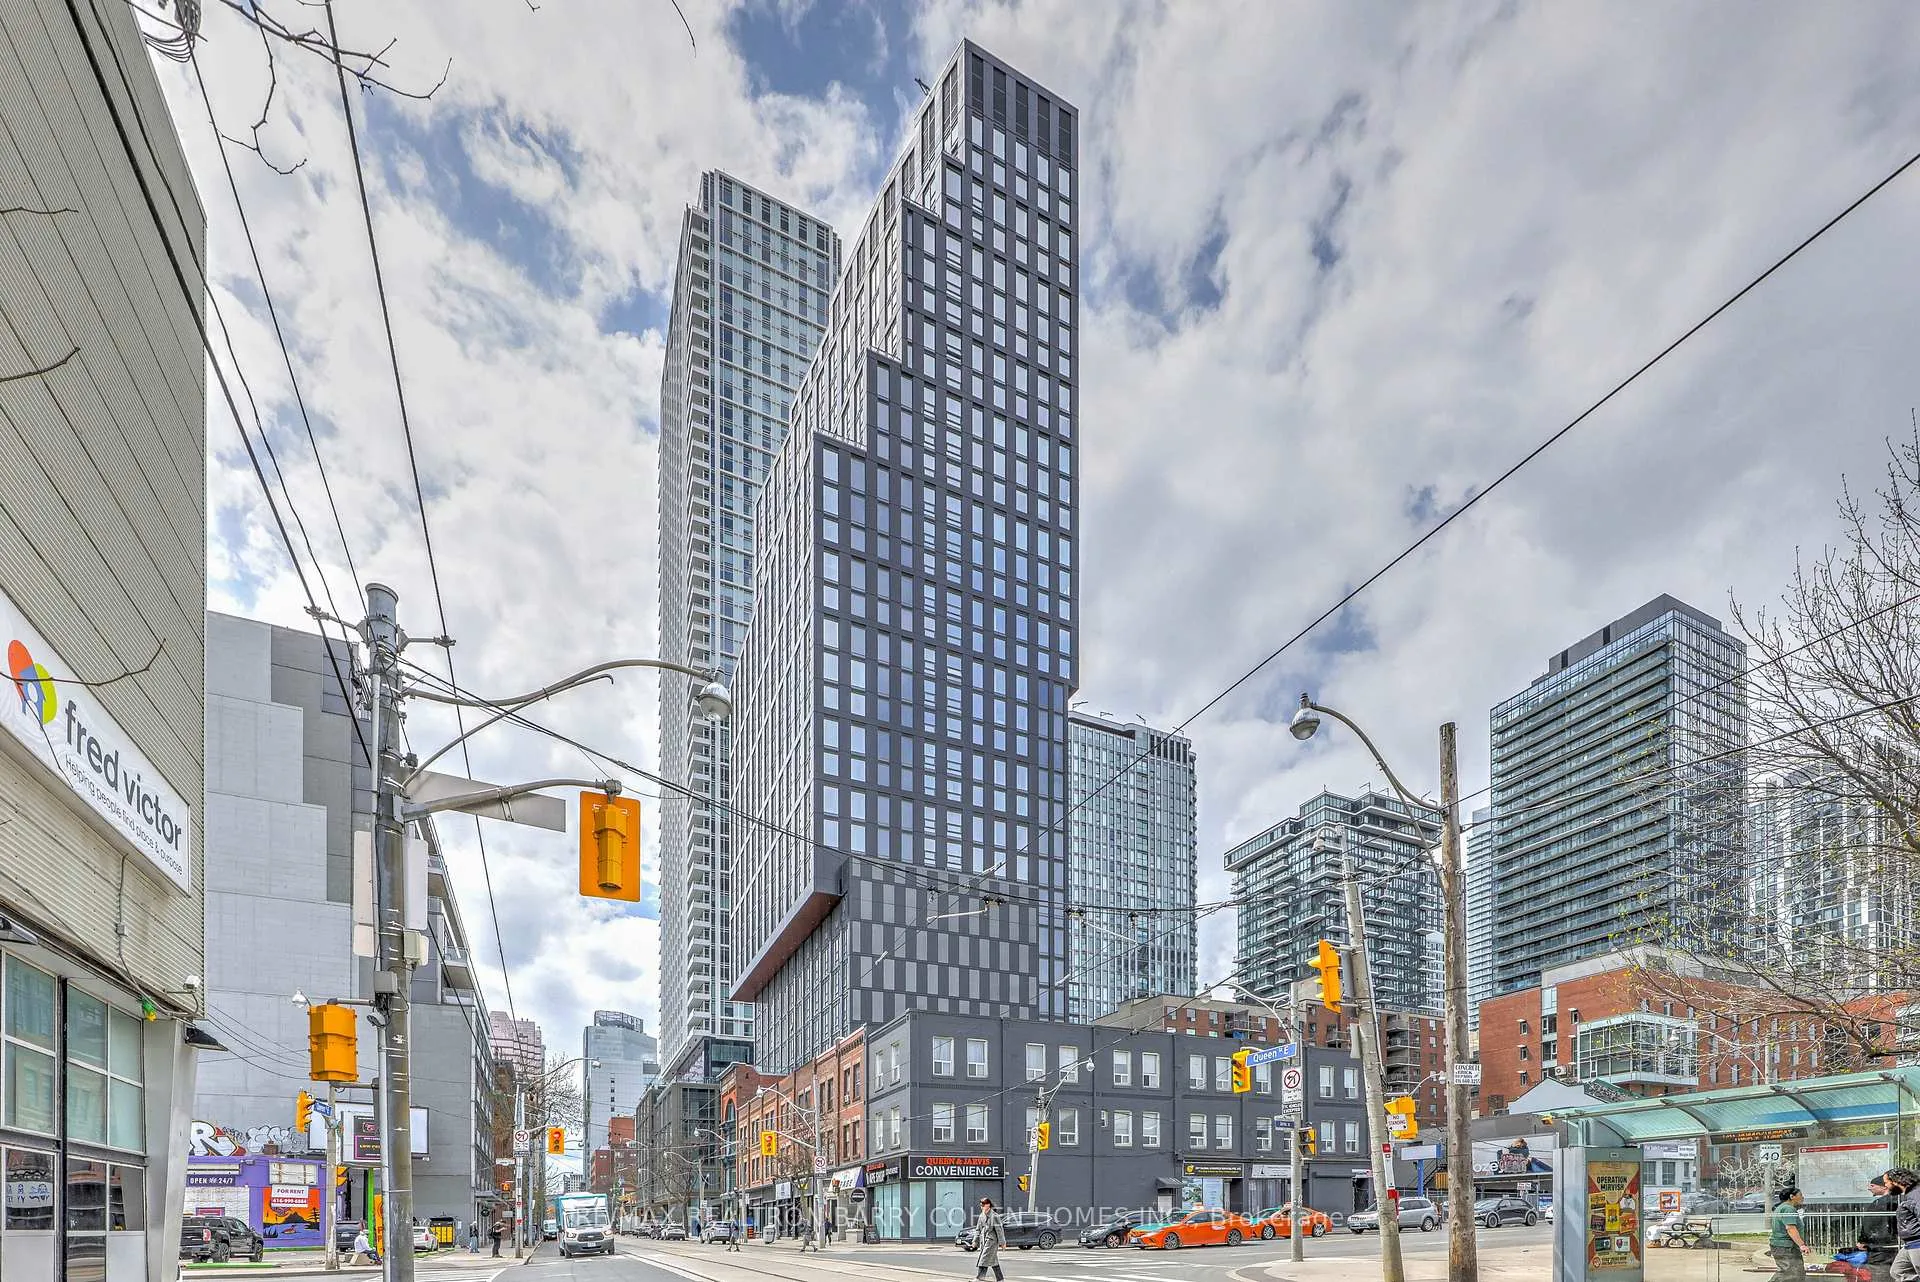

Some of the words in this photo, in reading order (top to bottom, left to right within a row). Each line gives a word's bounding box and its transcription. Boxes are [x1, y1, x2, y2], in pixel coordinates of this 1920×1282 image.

[64, 700, 119, 793] fred
[123, 770, 182, 851] victor
[65, 754, 95, 797] Helping
[96, 787, 122, 819] people
[122, 809, 135, 832] find
[136, 825, 154, 849] place
[160, 848, 183, 876] purpose
[1253, 1050, 1277, 1063] Queen
[1284, 1046, 1289, 1055] E
[926, 1157, 955, 1165] QUEEN
[1761, 1151, 1780, 1161] 40
[915, 1165, 999, 1176] CONVENIENCE
[1596, 1176, 1628, 1184] OPERATION
[1600, 1183, 1625, 1191] MIRVISH
